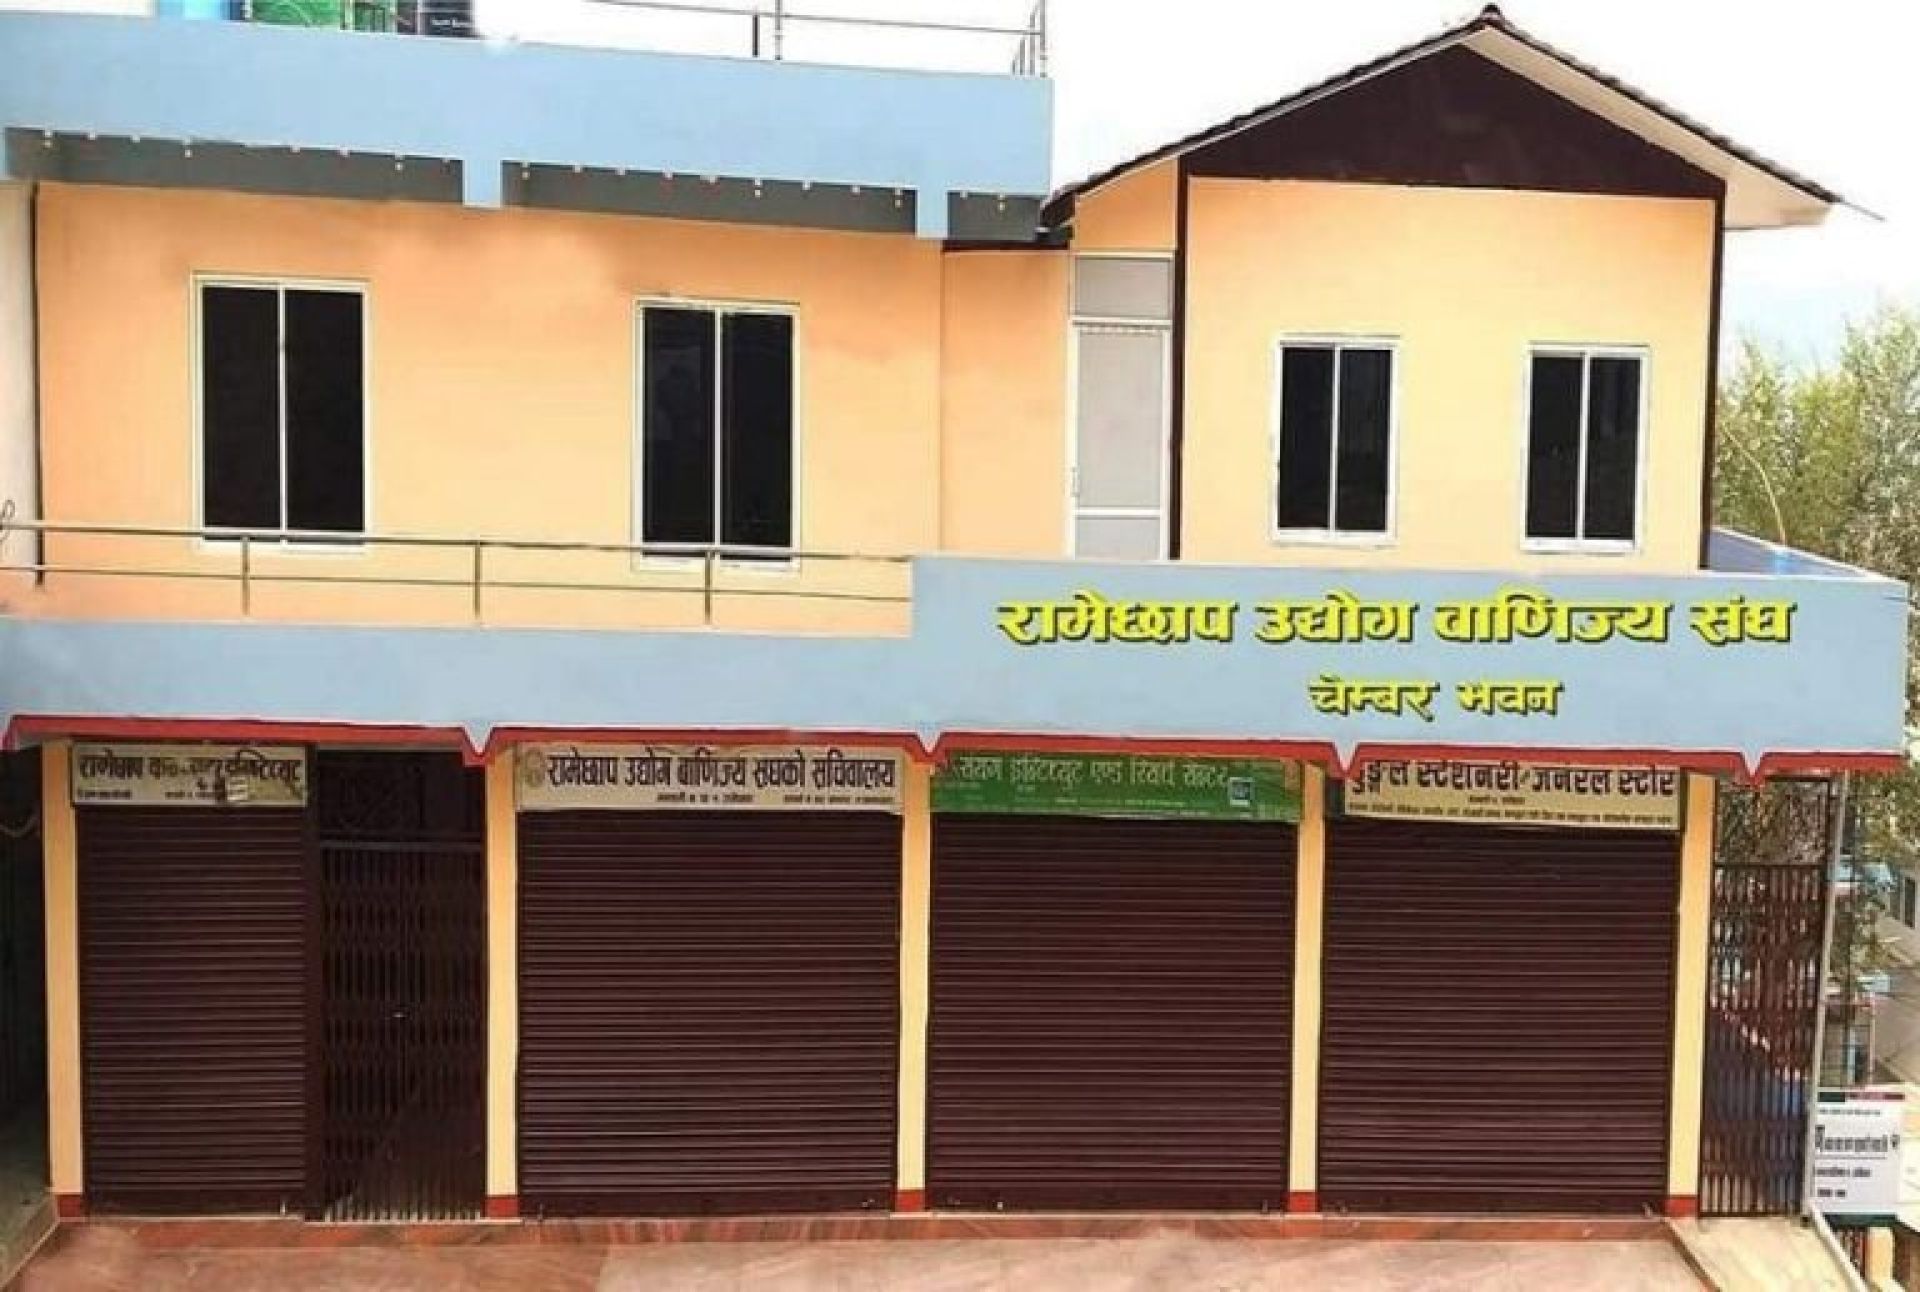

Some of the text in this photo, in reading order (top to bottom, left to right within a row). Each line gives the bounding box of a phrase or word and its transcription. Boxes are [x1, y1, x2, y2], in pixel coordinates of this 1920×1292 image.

[996, 588, 1240, 645] रामेछाप
[1254, 587, 1419, 643] उद्योग
[1689, 594, 1797, 645] संघ
[1455, 677, 1564, 717] भवन
[547, 746, 620, 787] रामेछाप
[810, 749, 896, 790] सचिवालय
